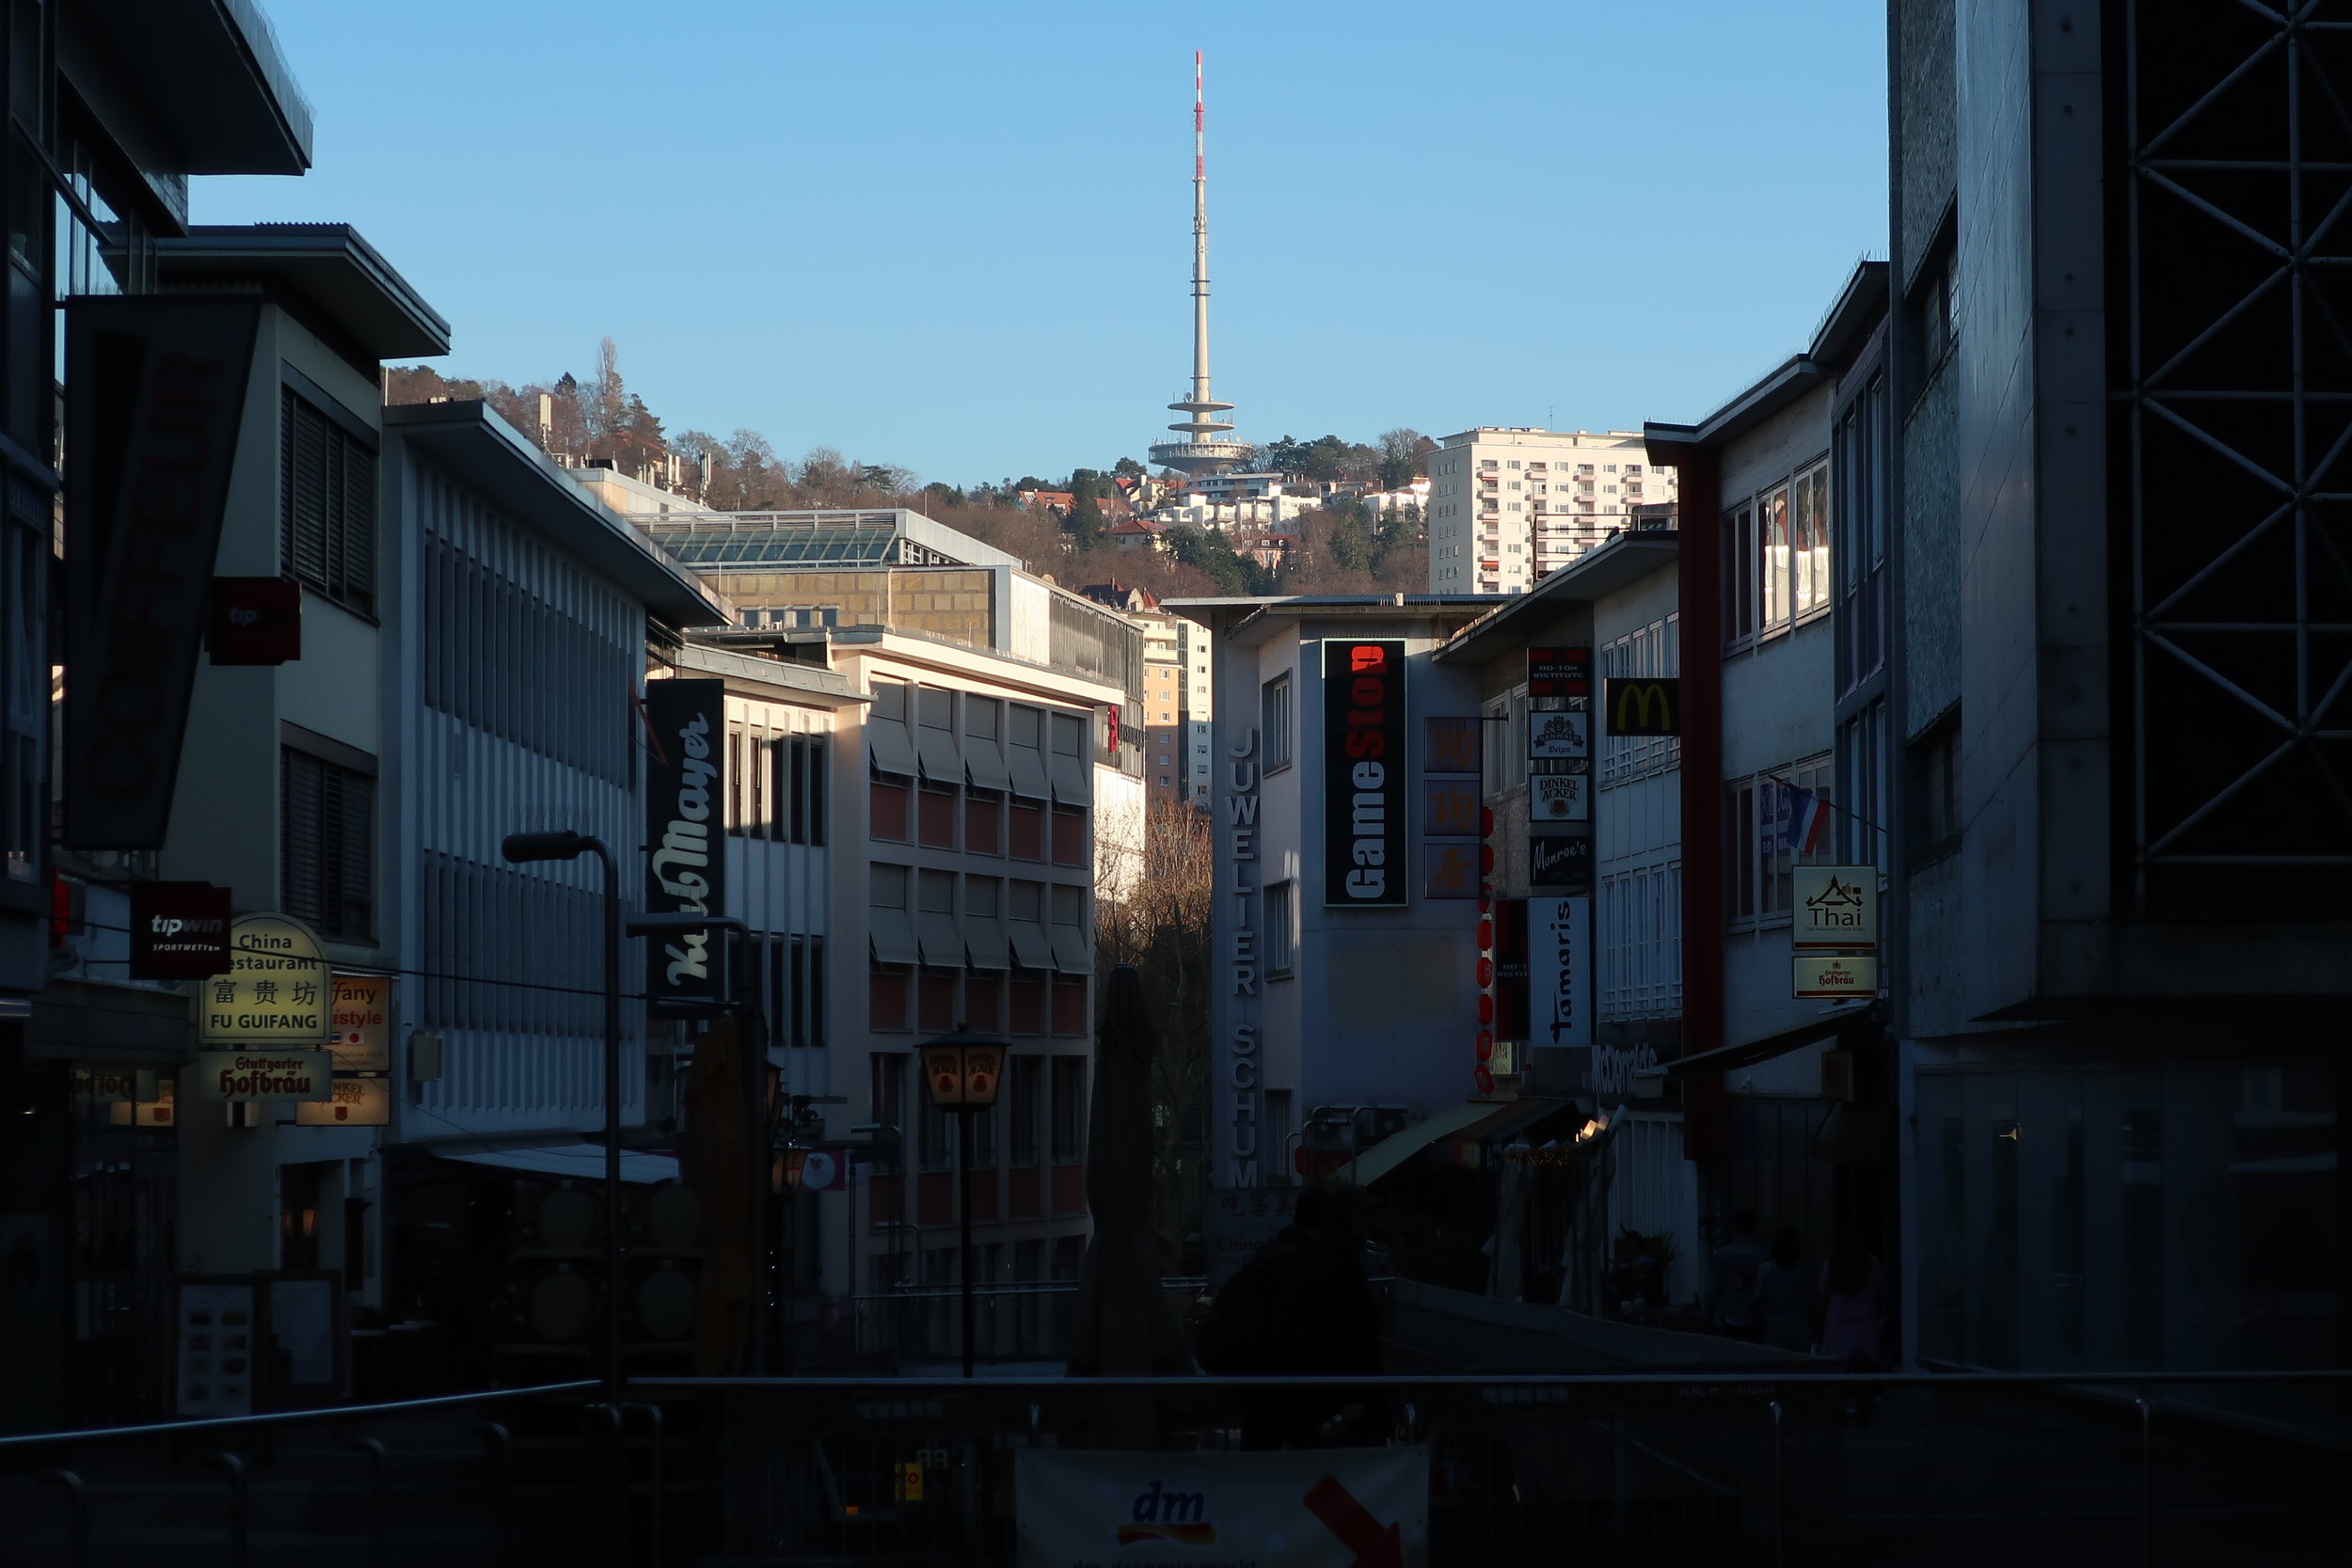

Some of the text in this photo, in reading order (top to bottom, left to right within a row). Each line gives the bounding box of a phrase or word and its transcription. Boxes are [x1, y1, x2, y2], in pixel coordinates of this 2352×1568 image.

[85, 351, 227, 806] COIFFEUR
[1345, 645, 1390, 899] GameStop
[652, 712, 718, 877] Mayer
[1540, 778, 1581, 792] DINKEL
[1542, 787, 1577, 801] ACKER
[1225, 728, 1259, 995] JUWELIER
[1534, 840, 1587, 881] Monroe's
[151, 914, 225, 937] tipwin
[1807, 908, 1861, 927] Thai
[152, 943, 221, 952] SPORTWETTEN
[239, 934, 294, 949] China
[230, 957, 318, 971] estaurant
[1549, 901, 1573, 1044] tamaris
[1819, 974, 1854, 987] Hofbräu
[214, 979, 318, 1006] 富贵坊
[211, 1015, 318, 1029] FU GUIFANG
[235, 1055, 304, 1072] Stuttgarter
[219, 1070, 311, 1098] Hofbräu
[1132, 1480, 1205, 1523] dm
